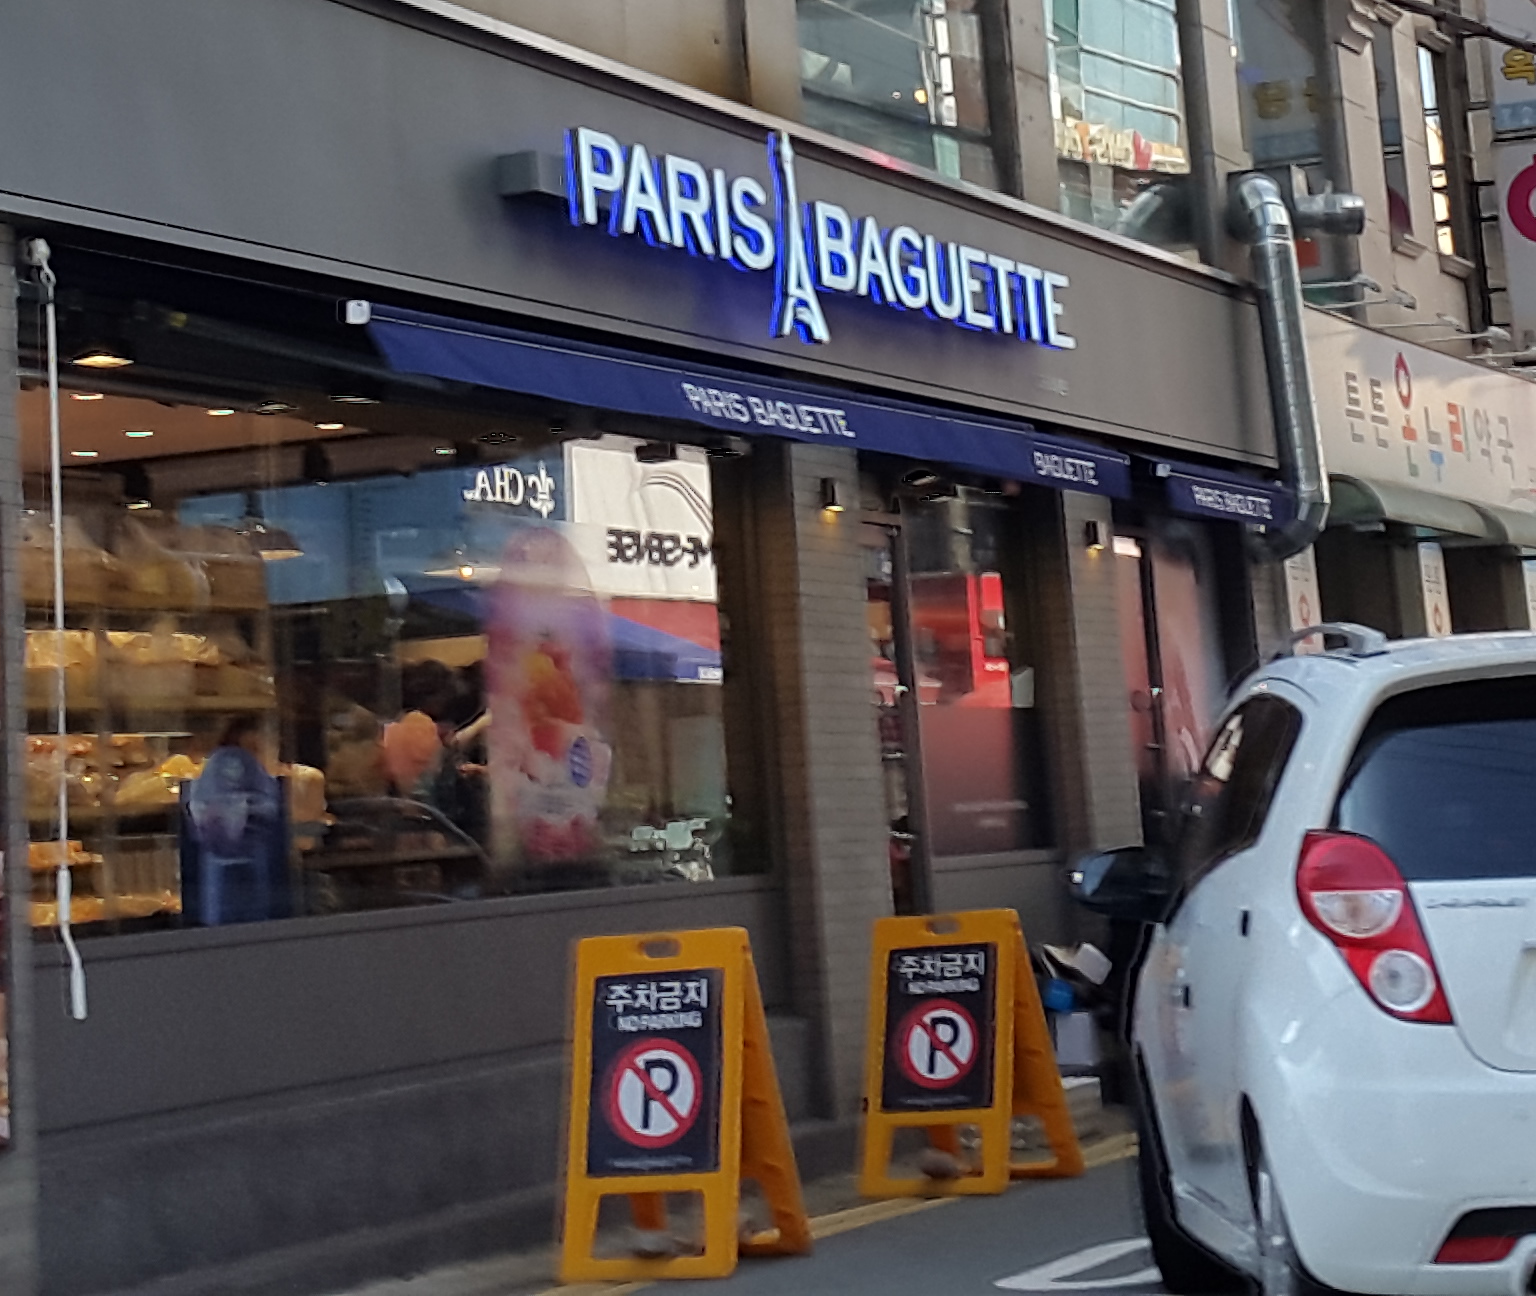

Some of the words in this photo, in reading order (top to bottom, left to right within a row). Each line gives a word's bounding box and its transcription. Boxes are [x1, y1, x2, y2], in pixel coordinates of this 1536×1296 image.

[574, 127, 776, 271] PARIS
[814, 203, 1078, 351] BAGUETTE
[682, 382, 750, 424] PARIS
[755, 396, 857, 440] BAGUETTE
[898, 950, 985, 980] 주차금지
[604, 978, 708, 1014] 주차금지
